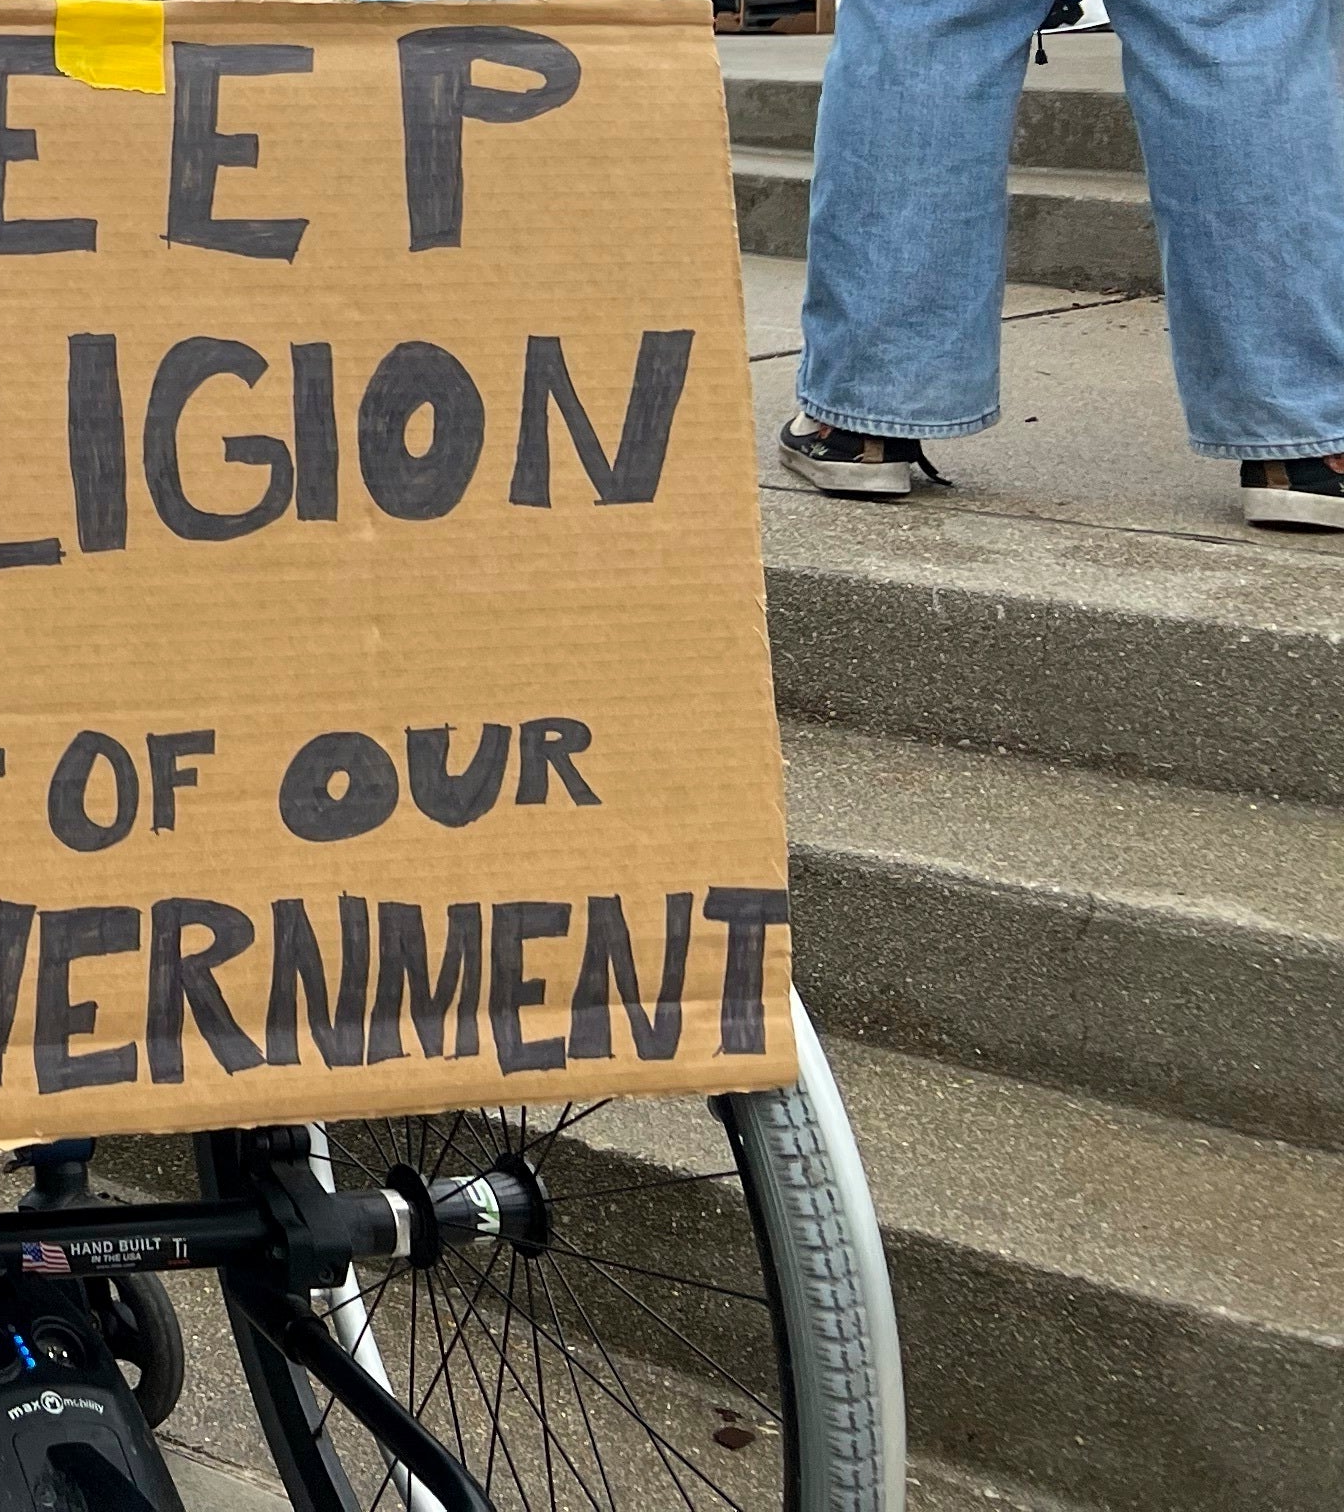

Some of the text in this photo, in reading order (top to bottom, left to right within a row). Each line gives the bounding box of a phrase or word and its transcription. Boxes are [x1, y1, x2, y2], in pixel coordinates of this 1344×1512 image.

[47, 731, 214, 853] OF
[279, 717, 601, 843] OUR
[70, 1237, 162, 1256] HAND BUILT
[172, 1237, 187, 1259] Ti
[91, 1251, 142, 1264] IN THE USA
[7, 1399, 41, 1420] max
